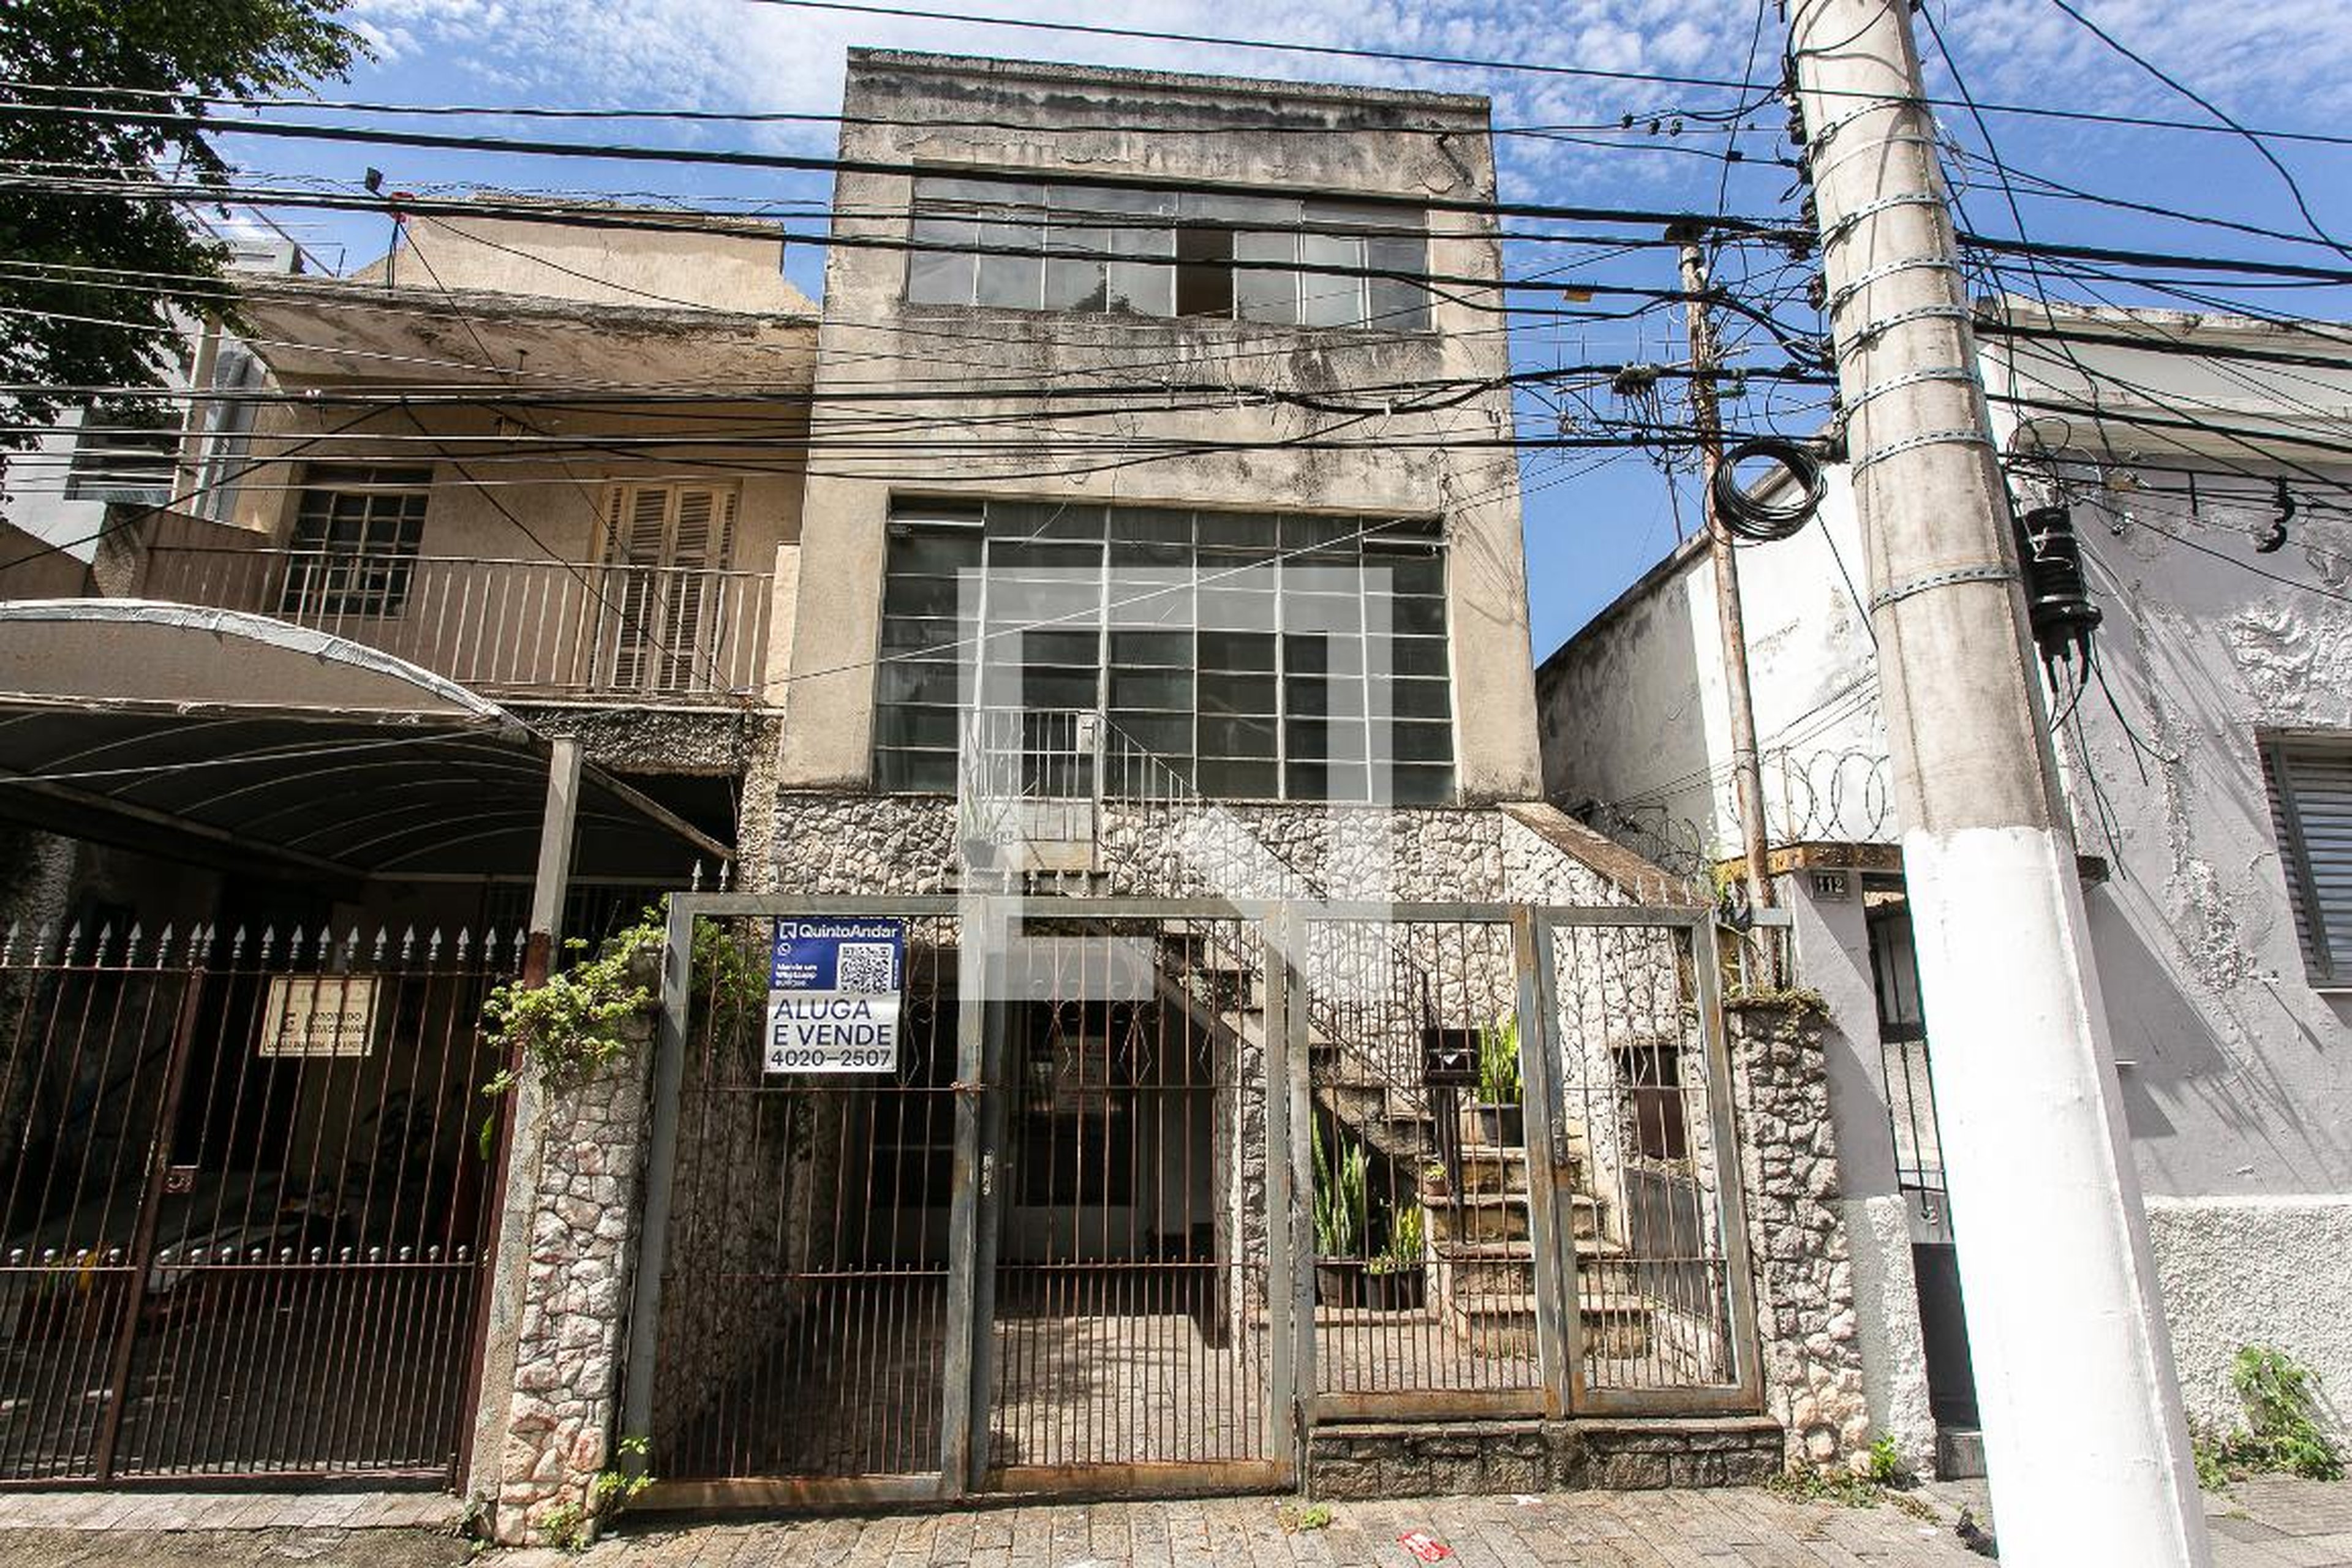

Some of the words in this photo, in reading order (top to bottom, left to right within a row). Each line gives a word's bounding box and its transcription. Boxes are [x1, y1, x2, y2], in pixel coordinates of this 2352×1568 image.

[1819, 877, 1844, 892] 112
[799, 924, 898, 938] QuintoAndar
[774, 999, 872, 1020] ALUGA
[773, 1024, 788, 1046] E
[797, 1024, 892, 1046] VENDE
[771, 1049, 891, 1066] 4020-2507
